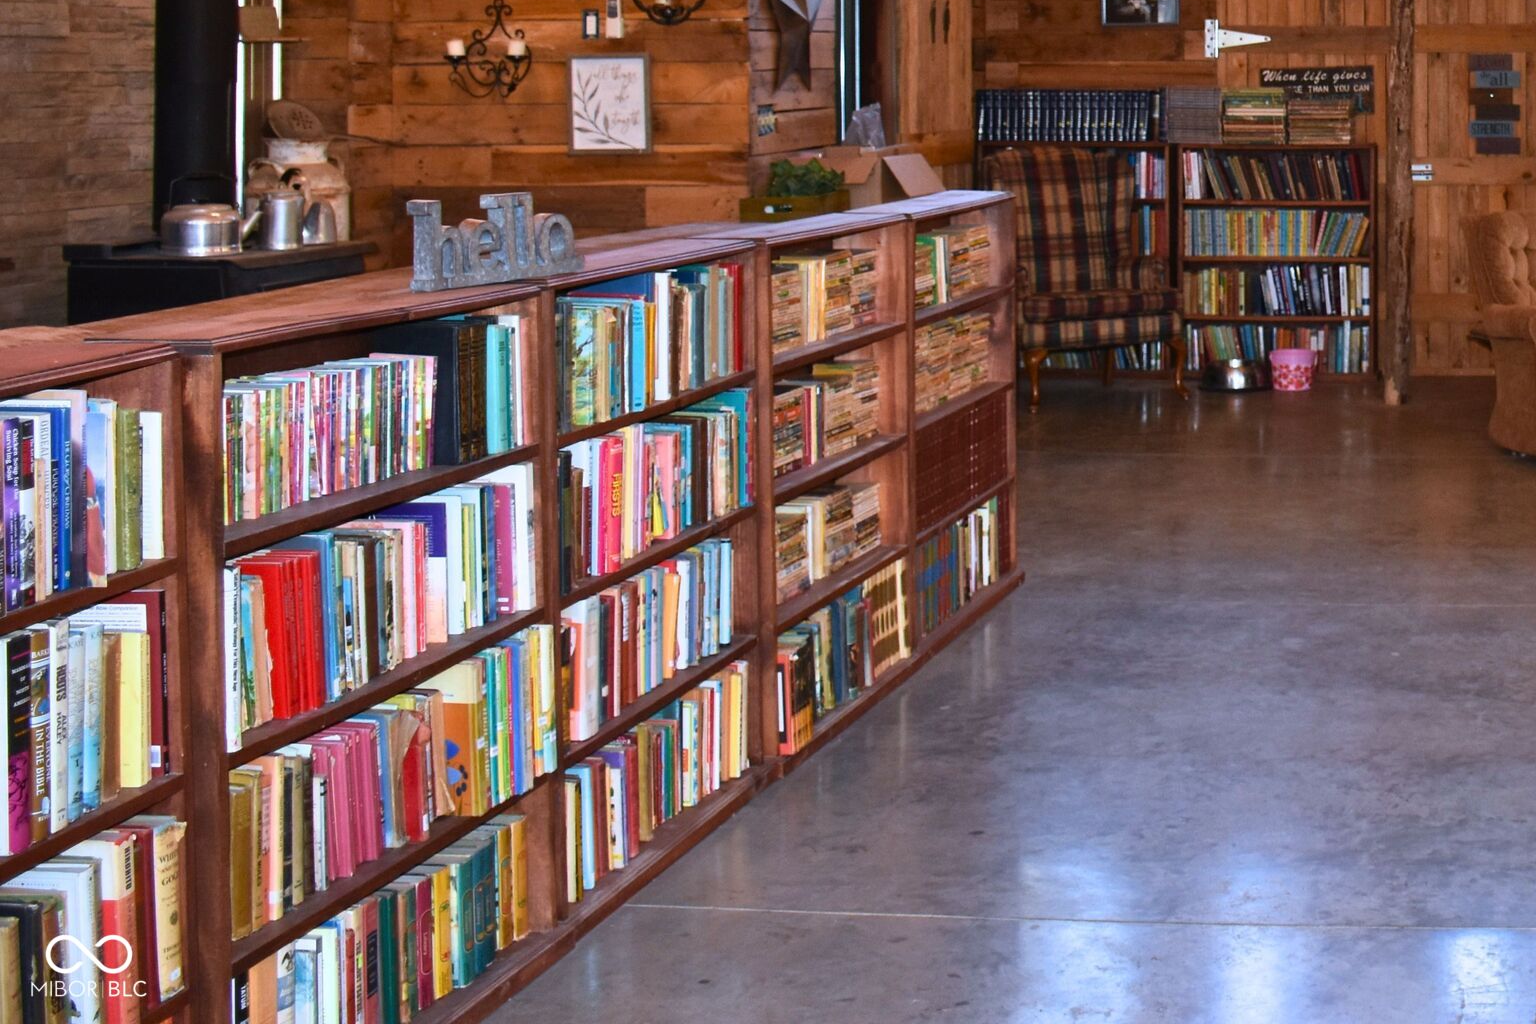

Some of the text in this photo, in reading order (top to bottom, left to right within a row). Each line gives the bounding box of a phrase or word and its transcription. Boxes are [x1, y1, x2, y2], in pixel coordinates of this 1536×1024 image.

[1262, 69, 1368, 85] When life gives
[1308, 85, 1330, 94] THAN
[1334, 84, 1351, 93] YOU
[1353, 84, 1371, 93] CAN
[406, 192, 585, 293] hello
[5, 430, 13, 481] Surviving Soul
[40, 420, 49, 457] ORDEAL
[611, 473, 623, 518] FIRSTS
[36, 728, 45, 796] IN THE BIBLE
